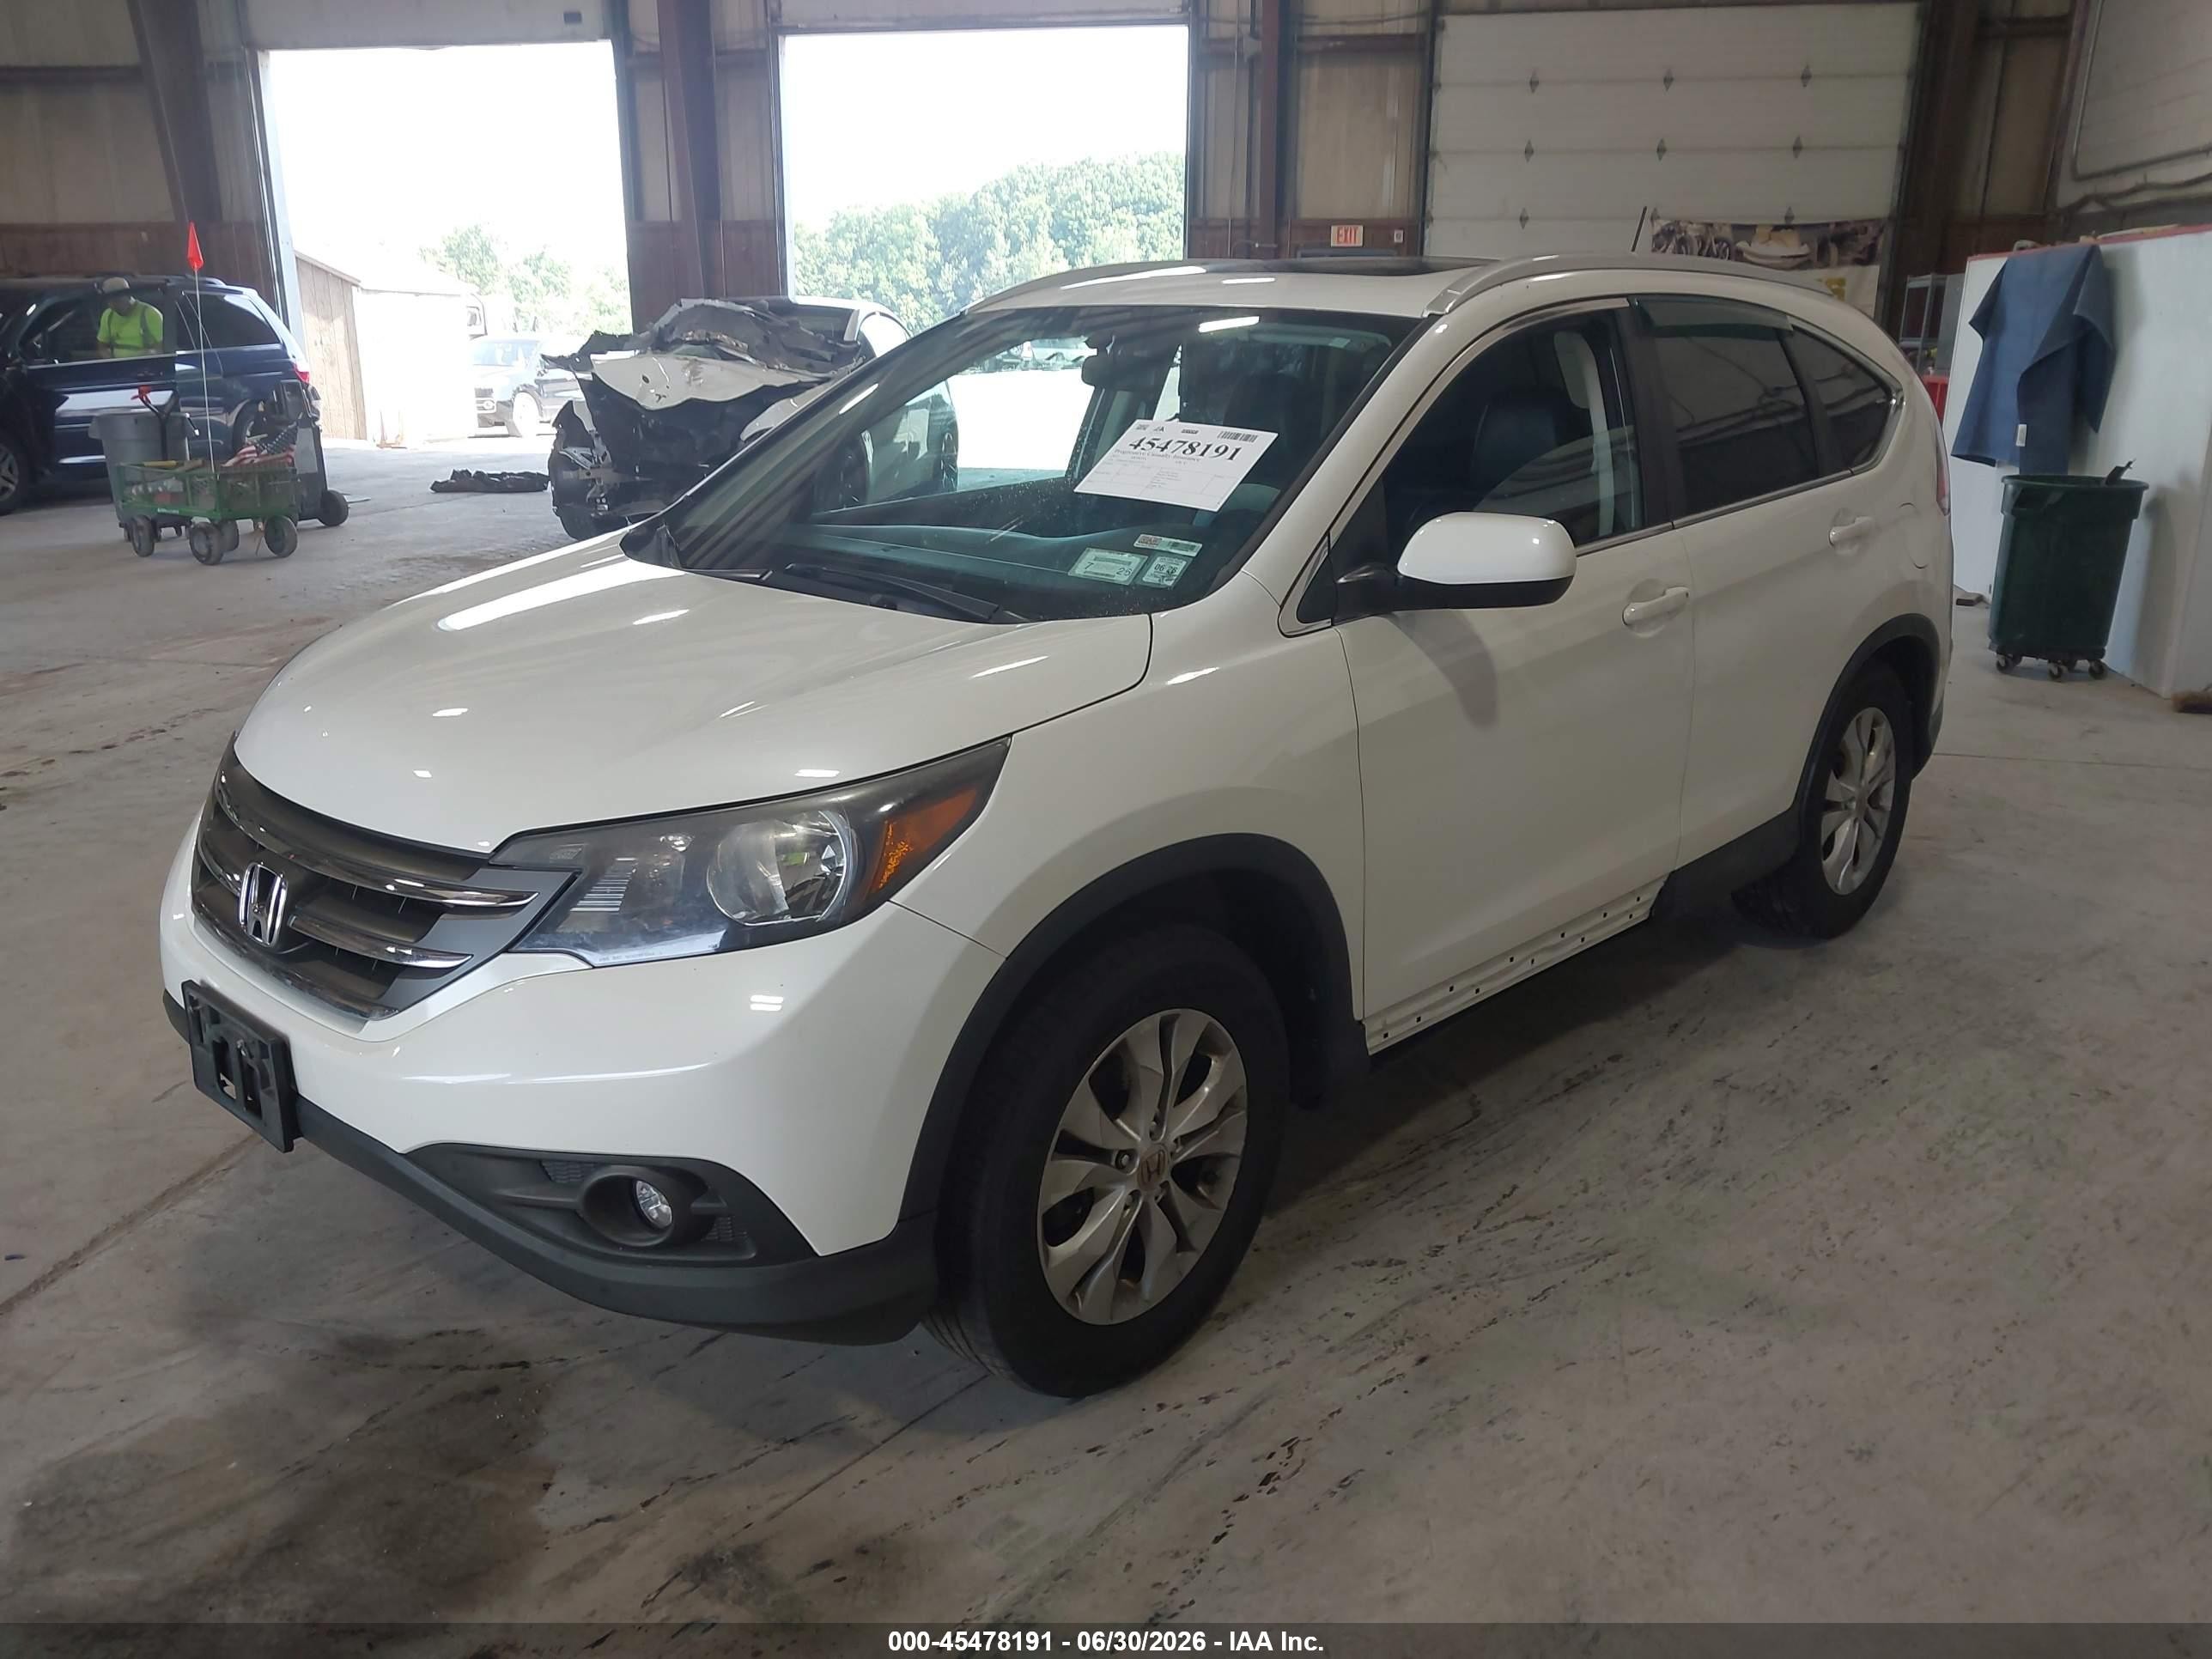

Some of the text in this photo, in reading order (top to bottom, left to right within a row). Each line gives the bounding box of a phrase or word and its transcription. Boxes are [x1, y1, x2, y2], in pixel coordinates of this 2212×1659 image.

[1336, 227, 1358, 243] EXIT
[1129, 437, 1242, 460] 45478191
[1154, 563, 1165, 572] 06
